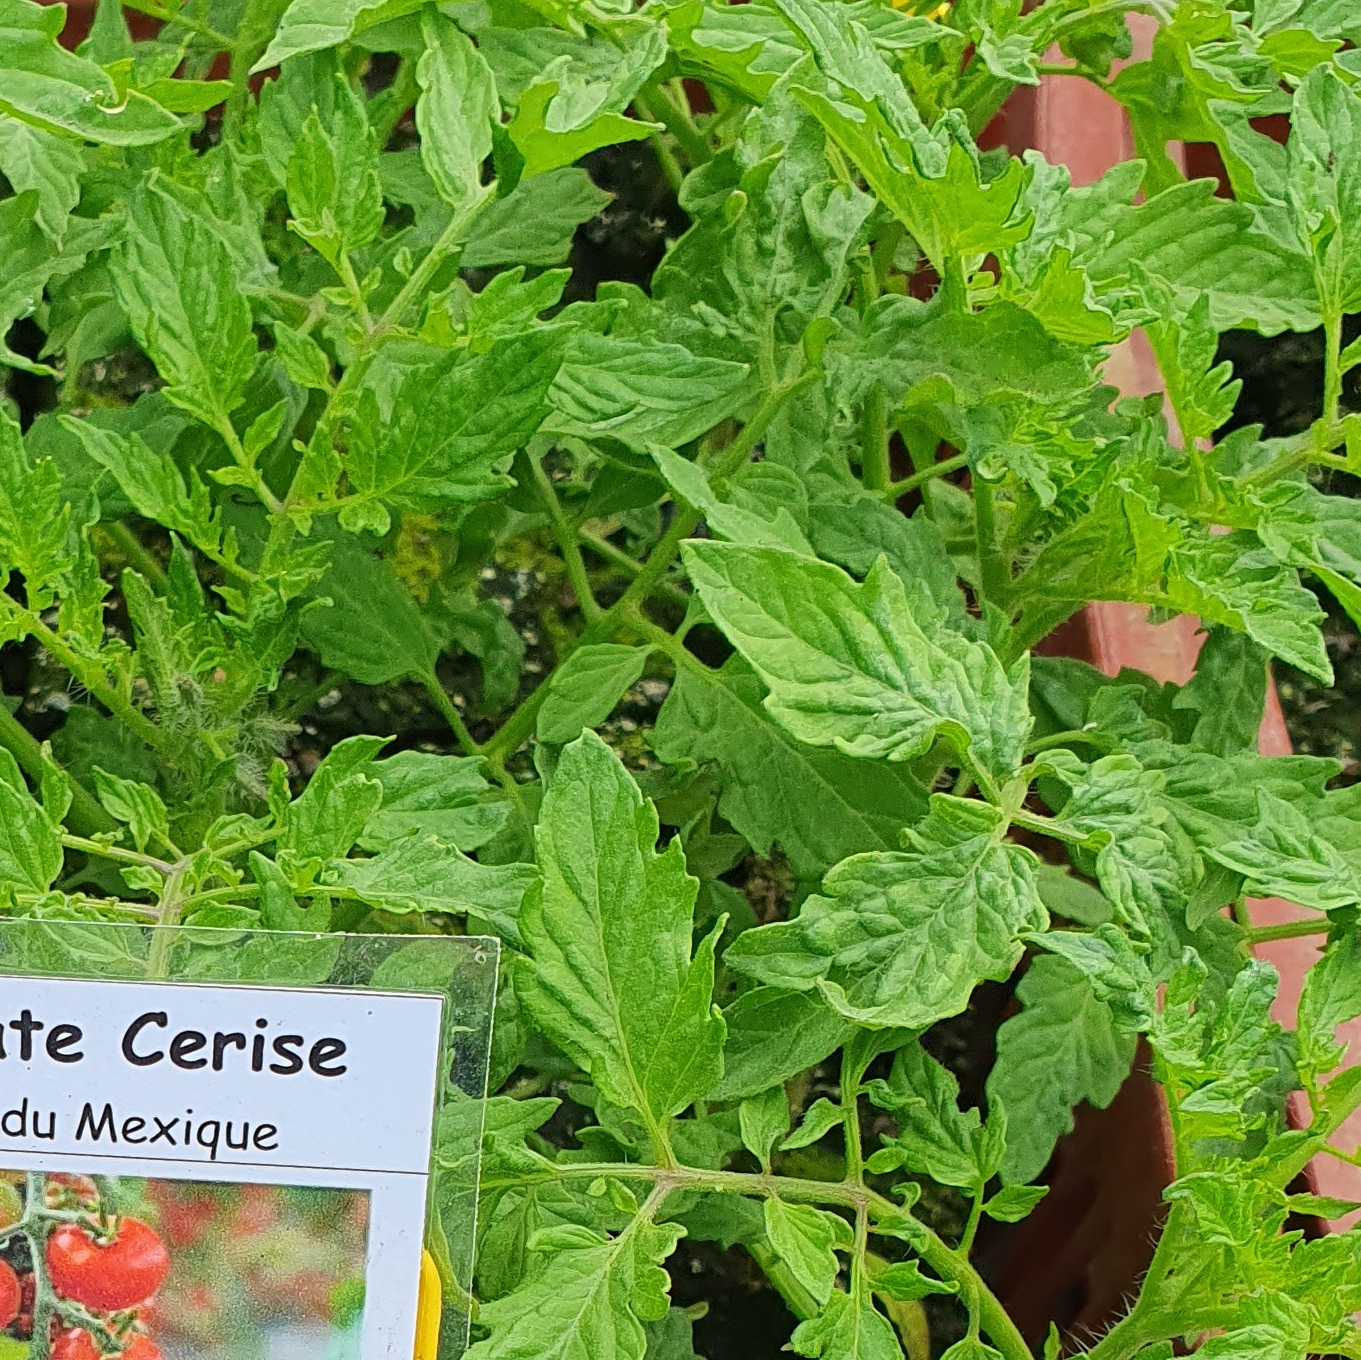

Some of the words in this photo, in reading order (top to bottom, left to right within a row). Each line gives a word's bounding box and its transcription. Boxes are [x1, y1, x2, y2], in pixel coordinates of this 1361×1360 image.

[120, 1010, 349, 1078] Cerise
[0, 1096, 57, 1140] du
[74, 1101, 280, 1162] Mexique
